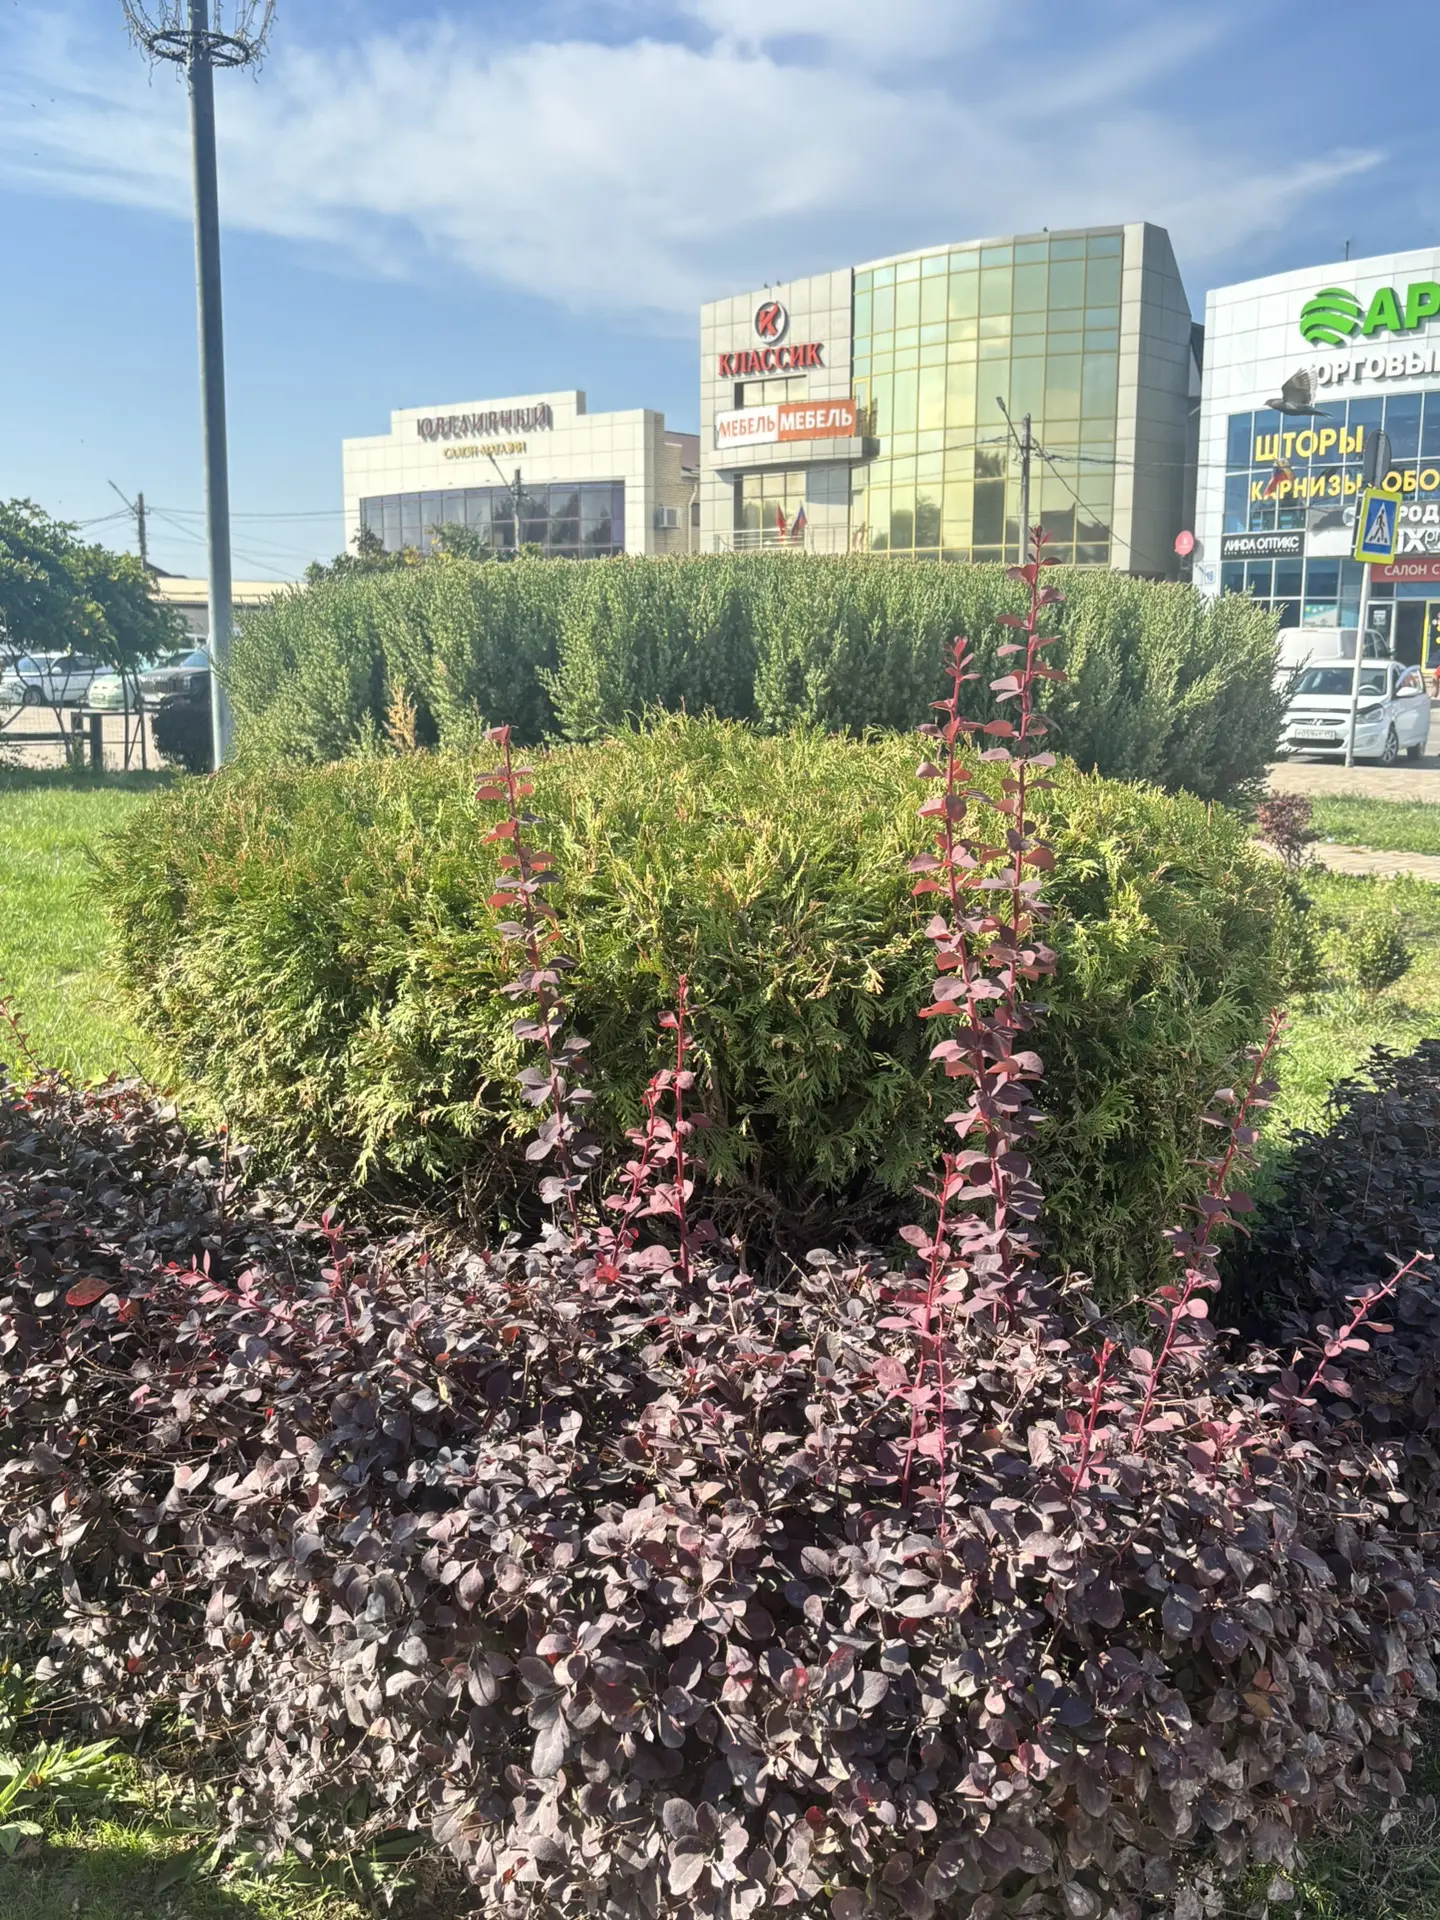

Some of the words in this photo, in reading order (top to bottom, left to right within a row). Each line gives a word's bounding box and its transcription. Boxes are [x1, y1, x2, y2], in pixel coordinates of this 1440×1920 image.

[718, 342, 823, 376] КЛАССИК
[1306, 351, 1440, 386] ОРГОВЫ
[416, 402, 549, 438] ЮВЕЛИРНЫЙ
[718, 416, 776, 439] МЕБЕЛЬ
[779, 408, 853, 432] МЕБЕЛЬ
[1255, 425, 1364, 462] ШТОРЫ
[1397, 504, 1440, 524] РОД
[1256, 536, 1300, 550] ОПТИКС
[1384, 564, 1427, 576] САЛОН
